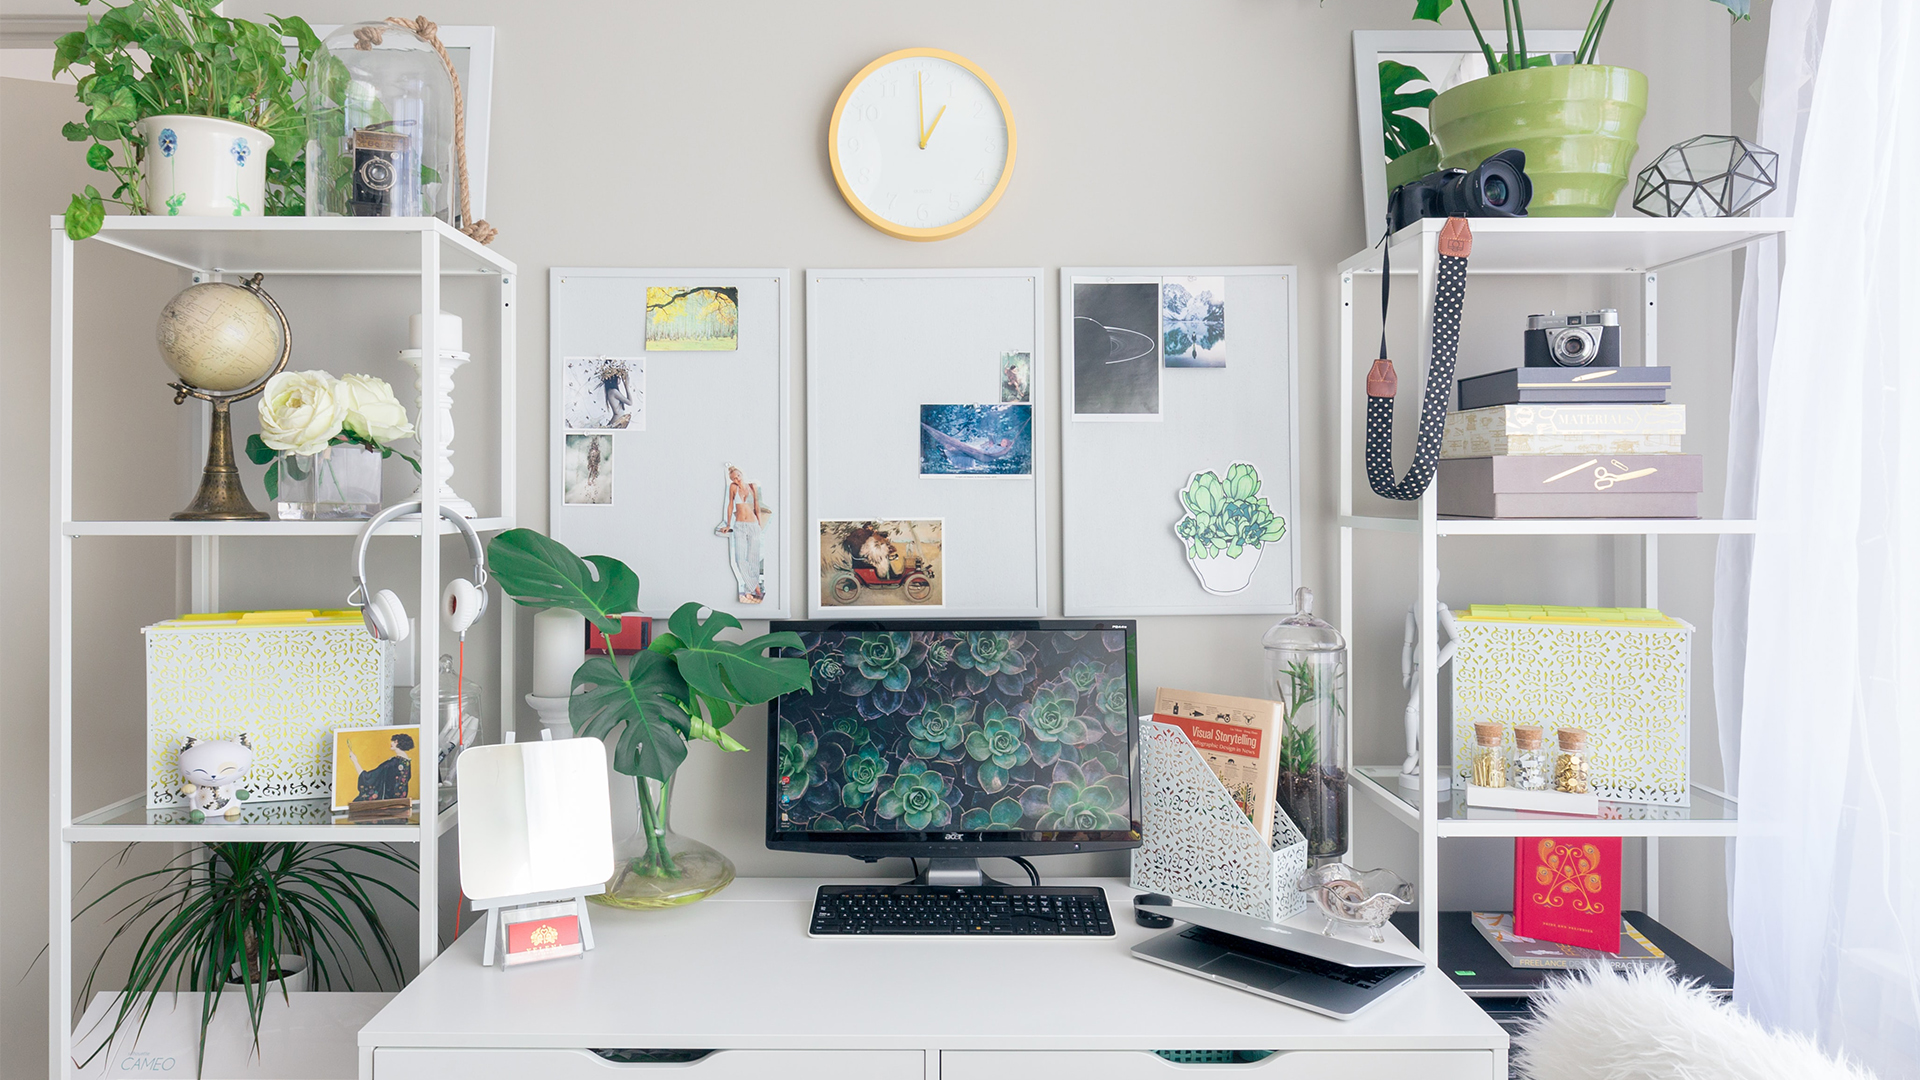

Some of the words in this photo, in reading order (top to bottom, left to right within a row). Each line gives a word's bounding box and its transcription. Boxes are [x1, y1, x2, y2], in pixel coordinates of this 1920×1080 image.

[909, 69, 934, 87] 12
[879, 80, 899, 99] 11
[946, 80, 956, 99] 1
[856, 104, 879, 122] 10
[972, 100, 987, 120] 2
[847, 136, 860, 155] 9
[984, 135, 996, 154] 3
[857, 166, 870, 186] 8
[974, 167, 989, 186] 4
[886, 191, 899, 211] 7
[947, 192, 961, 211] 5
[916, 203, 929, 222] 6
[1558, 413, 1635, 425] MATERIALS
[1192, 726, 1214, 740] Visual
[1215, 729, 1257, 749] Storytelling
[1219, 744, 1236, 752] Design
[945, 832, 964, 841] acer
[1519, 959, 1567, 967] FREELANCE
[120, 1056, 176, 1071] CAMEO
